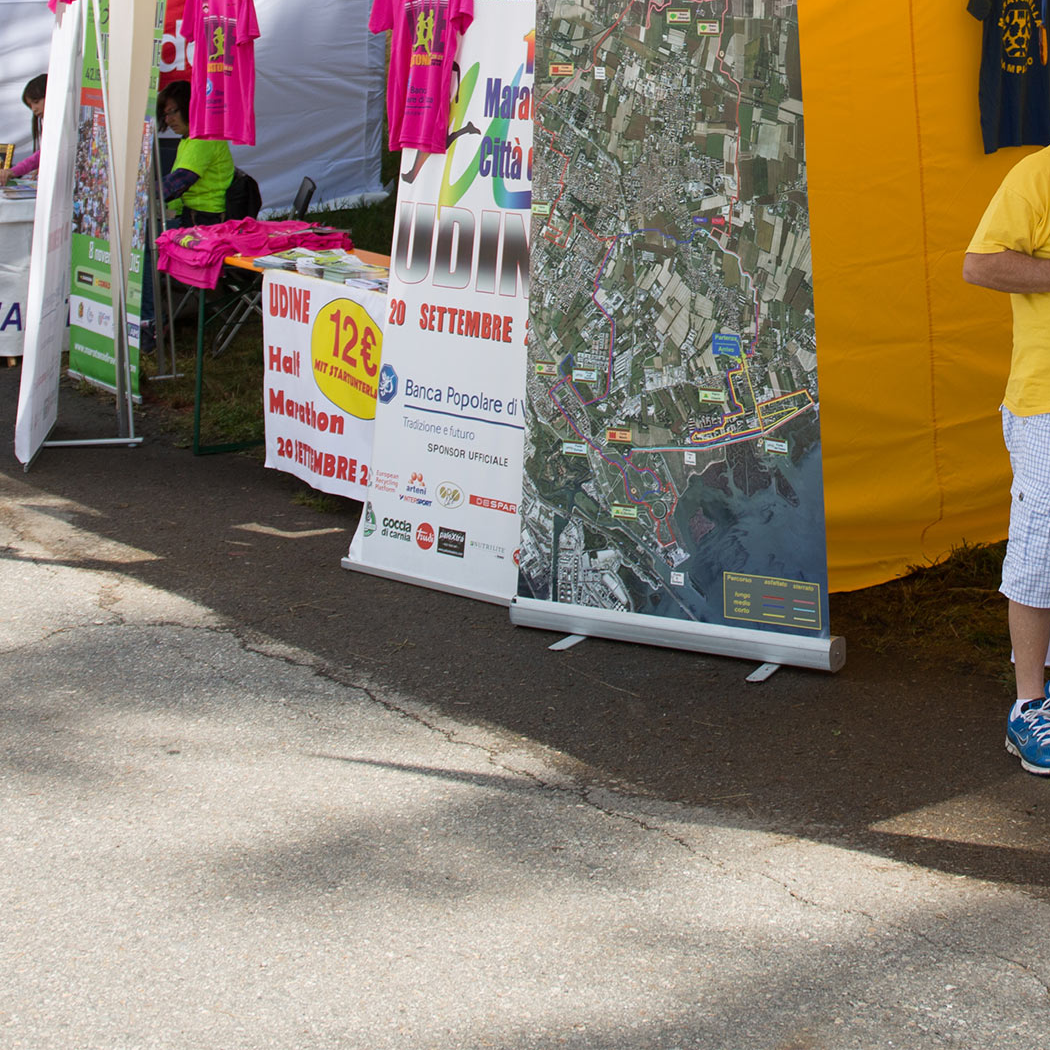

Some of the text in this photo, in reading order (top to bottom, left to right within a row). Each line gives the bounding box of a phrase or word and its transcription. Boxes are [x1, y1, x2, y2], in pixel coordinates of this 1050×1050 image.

[479, 135, 522, 180] Città
[269, 283, 311, 324] UDINE
[389, 298, 512, 343] 20 SETTEMBRE
[330, 309, 377, 377] 12€
[269, 346, 300, 378] Half
[315, 359, 328, 376] MIT
[269, 388, 344, 434] Marathon
[405, 379, 517, 416] Banca Popolare di
[403, 417, 475, 440] Tradizione futuro
[277, 437, 357, 483] 20 SETTEMBRE
[427, 443, 508, 467] SPONSOR UFFICIALE
[404, 495, 432, 507] INTERSPORT
[406, 485, 427, 495] arteni
[476, 497, 516, 513] DESPAR
[381, 528, 411, 542] di carnia
